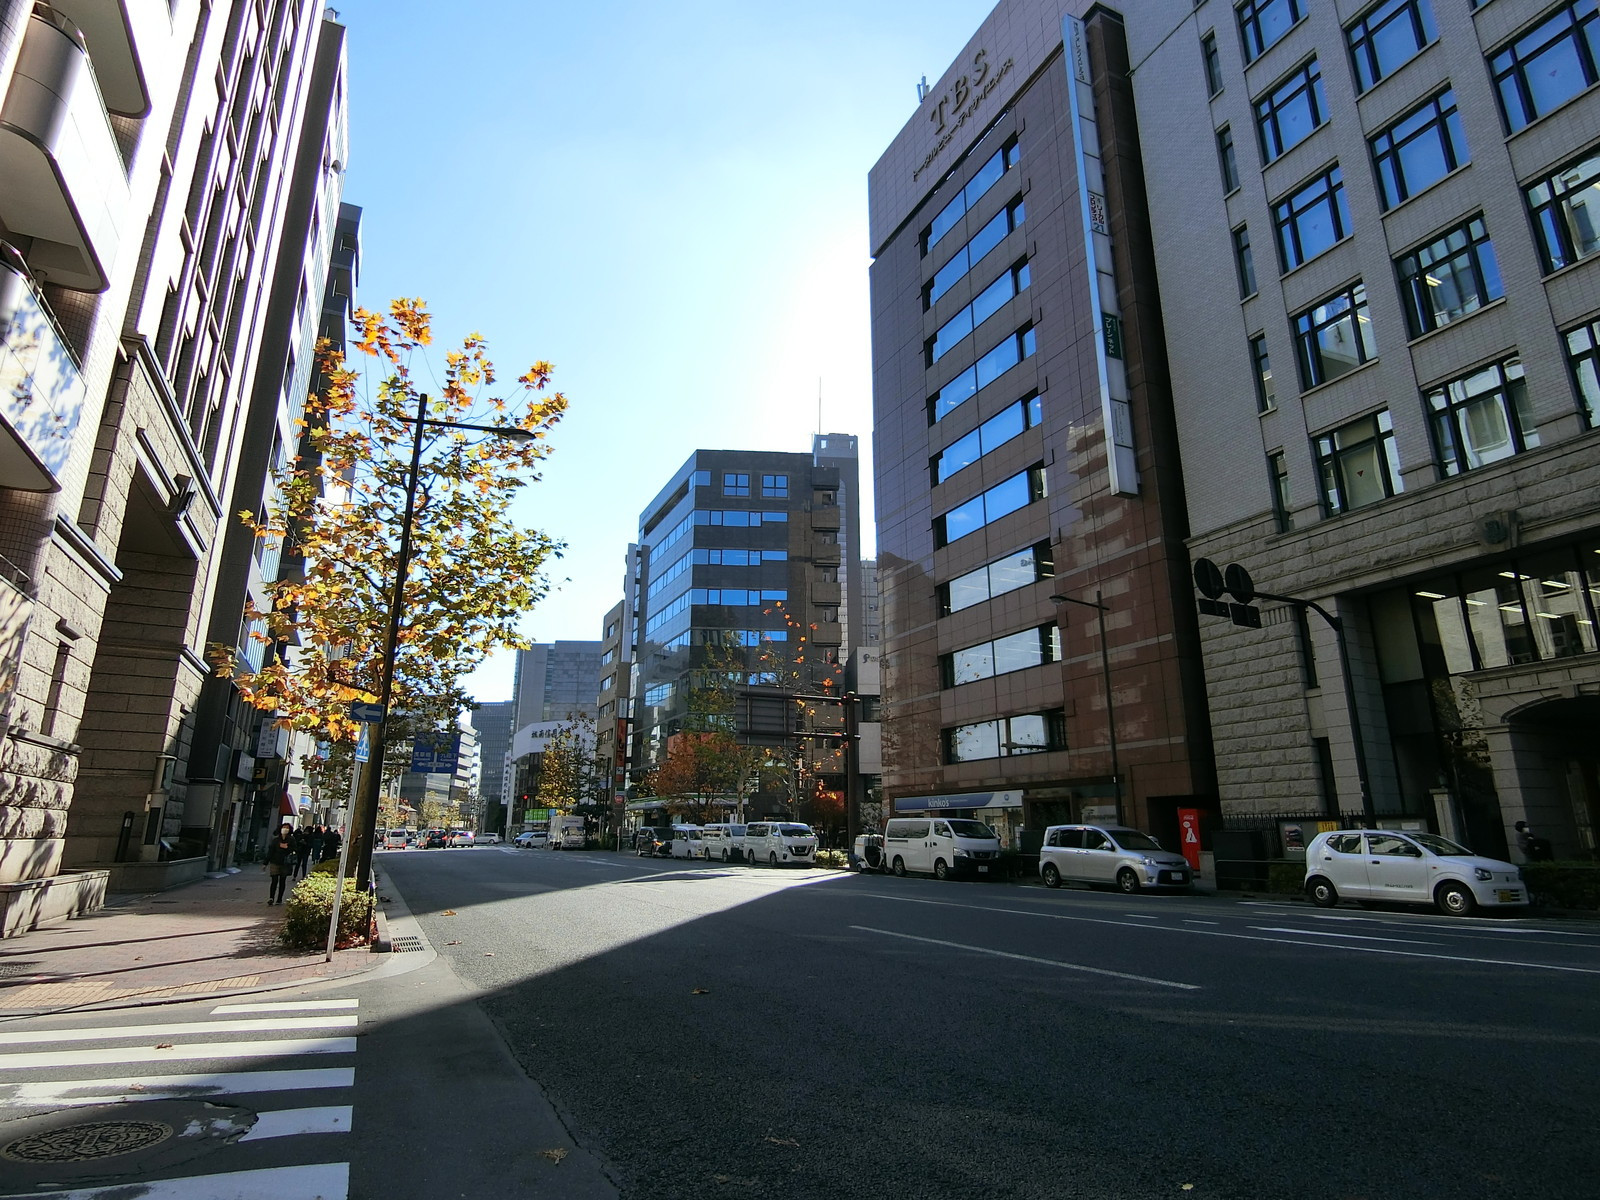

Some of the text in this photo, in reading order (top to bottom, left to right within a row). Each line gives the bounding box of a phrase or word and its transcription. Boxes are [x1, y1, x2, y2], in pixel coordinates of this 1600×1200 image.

[930, 48, 989, 135] TBS
[1093, 222, 1104, 233] 21
[254, 768, 262, 778] P
[927, 798, 950, 808] kinko's
